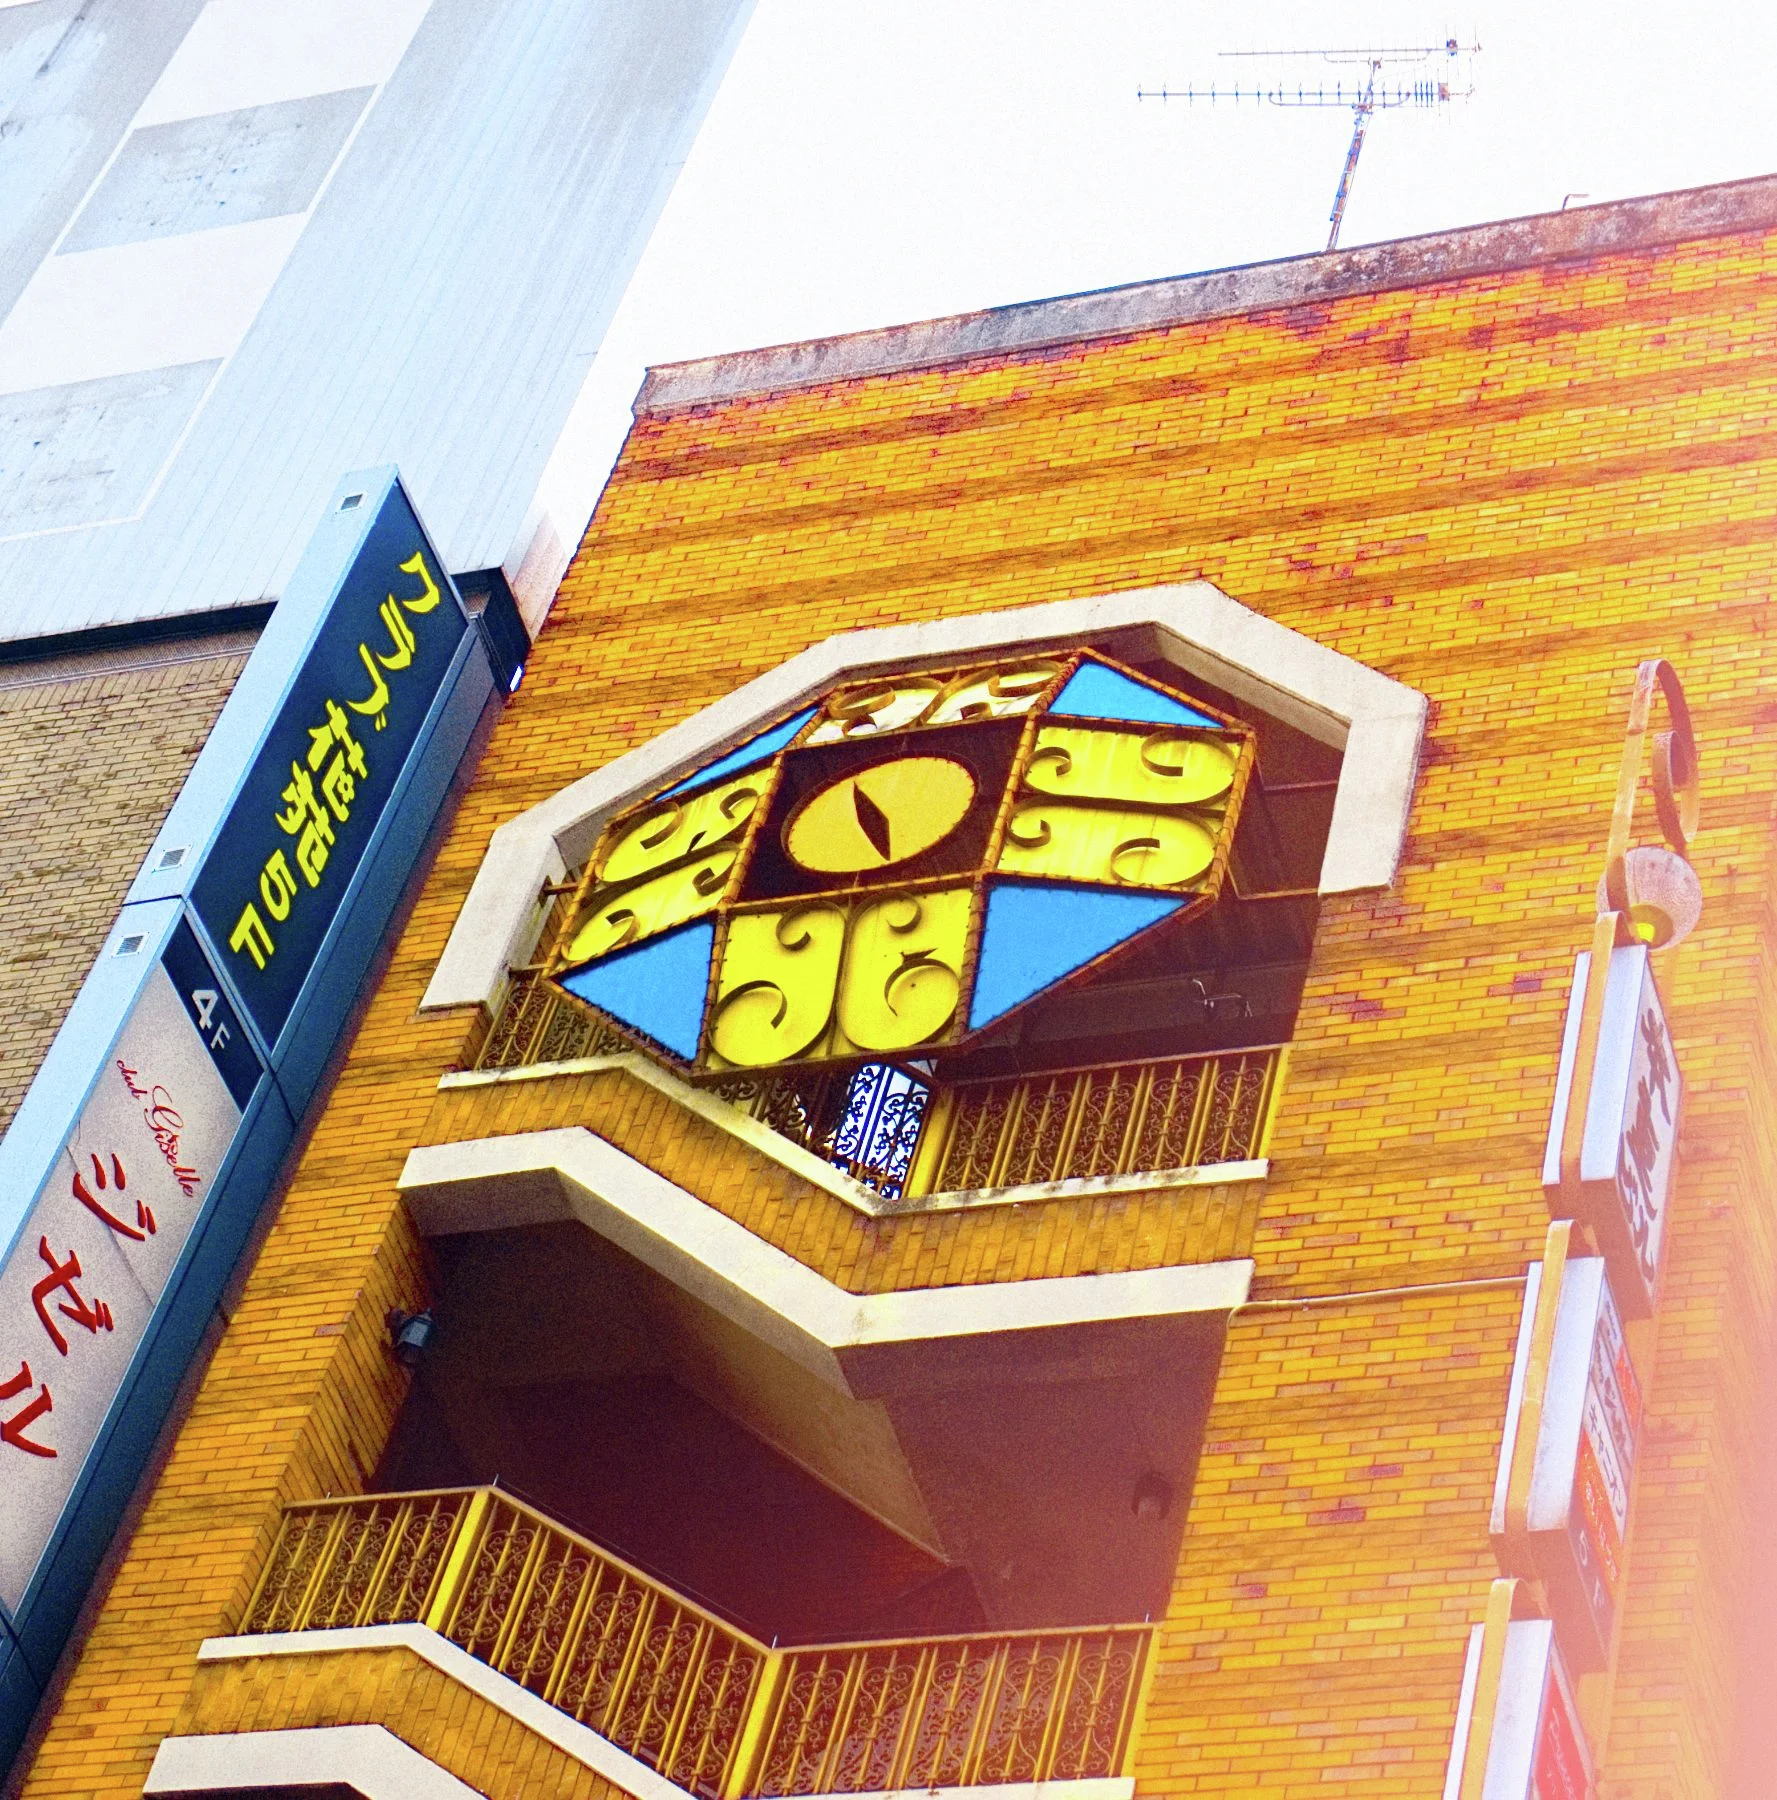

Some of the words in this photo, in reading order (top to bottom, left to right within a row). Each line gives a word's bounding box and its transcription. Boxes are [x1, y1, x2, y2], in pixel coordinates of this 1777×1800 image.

[191, 989, 231, 1049] 4F
[116, 1059, 149, 1101] club
[143, 1085, 201, 1198] Giselle
[0, 1152, 157, 1458] ジゼル
